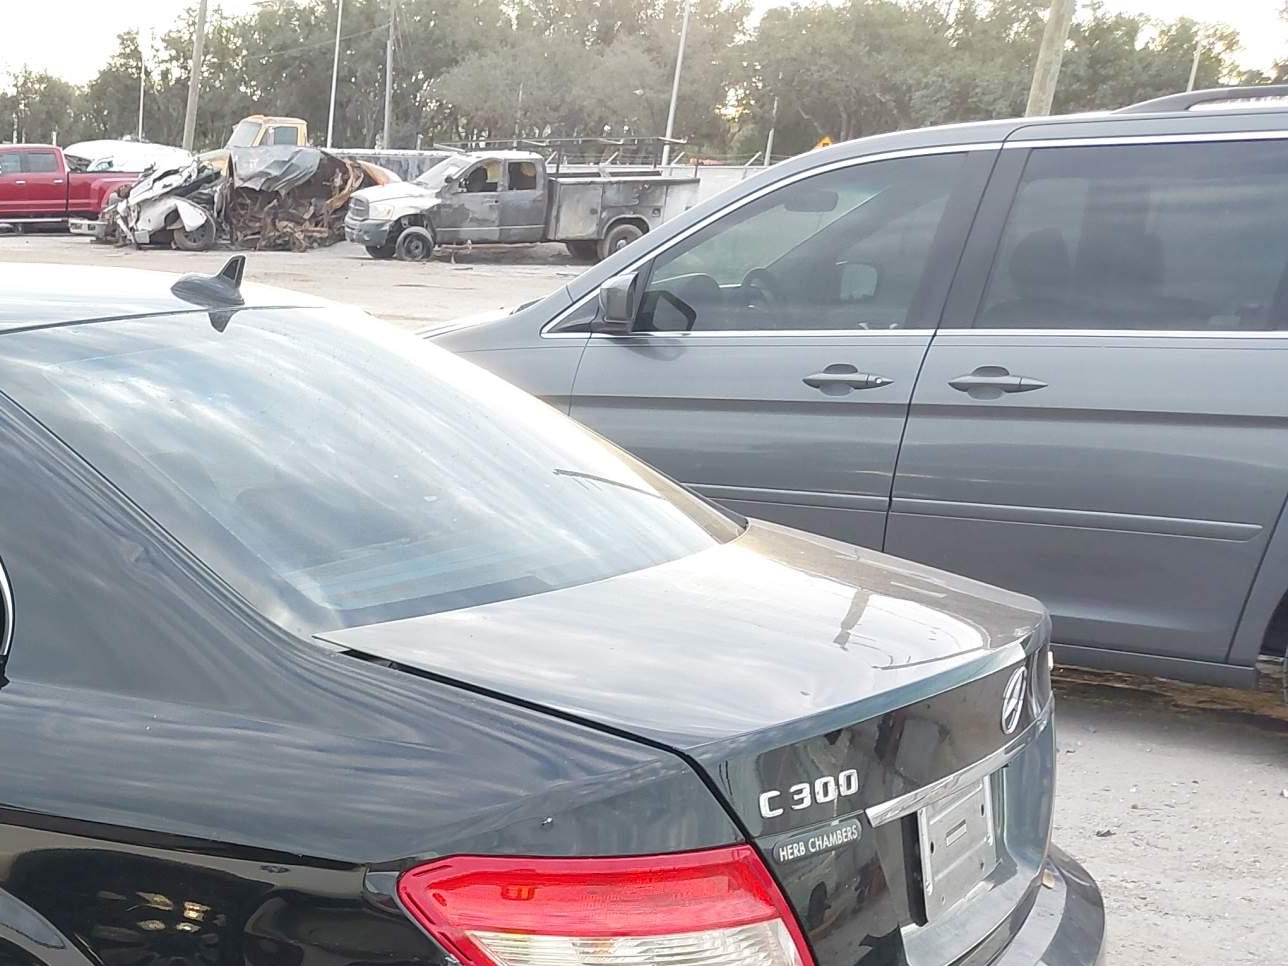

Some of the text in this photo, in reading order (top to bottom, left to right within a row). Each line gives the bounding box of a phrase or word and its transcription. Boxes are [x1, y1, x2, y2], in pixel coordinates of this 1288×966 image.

[759, 769, 859, 819] C 300
[779, 825, 858, 862] HERB CHAMBERS
